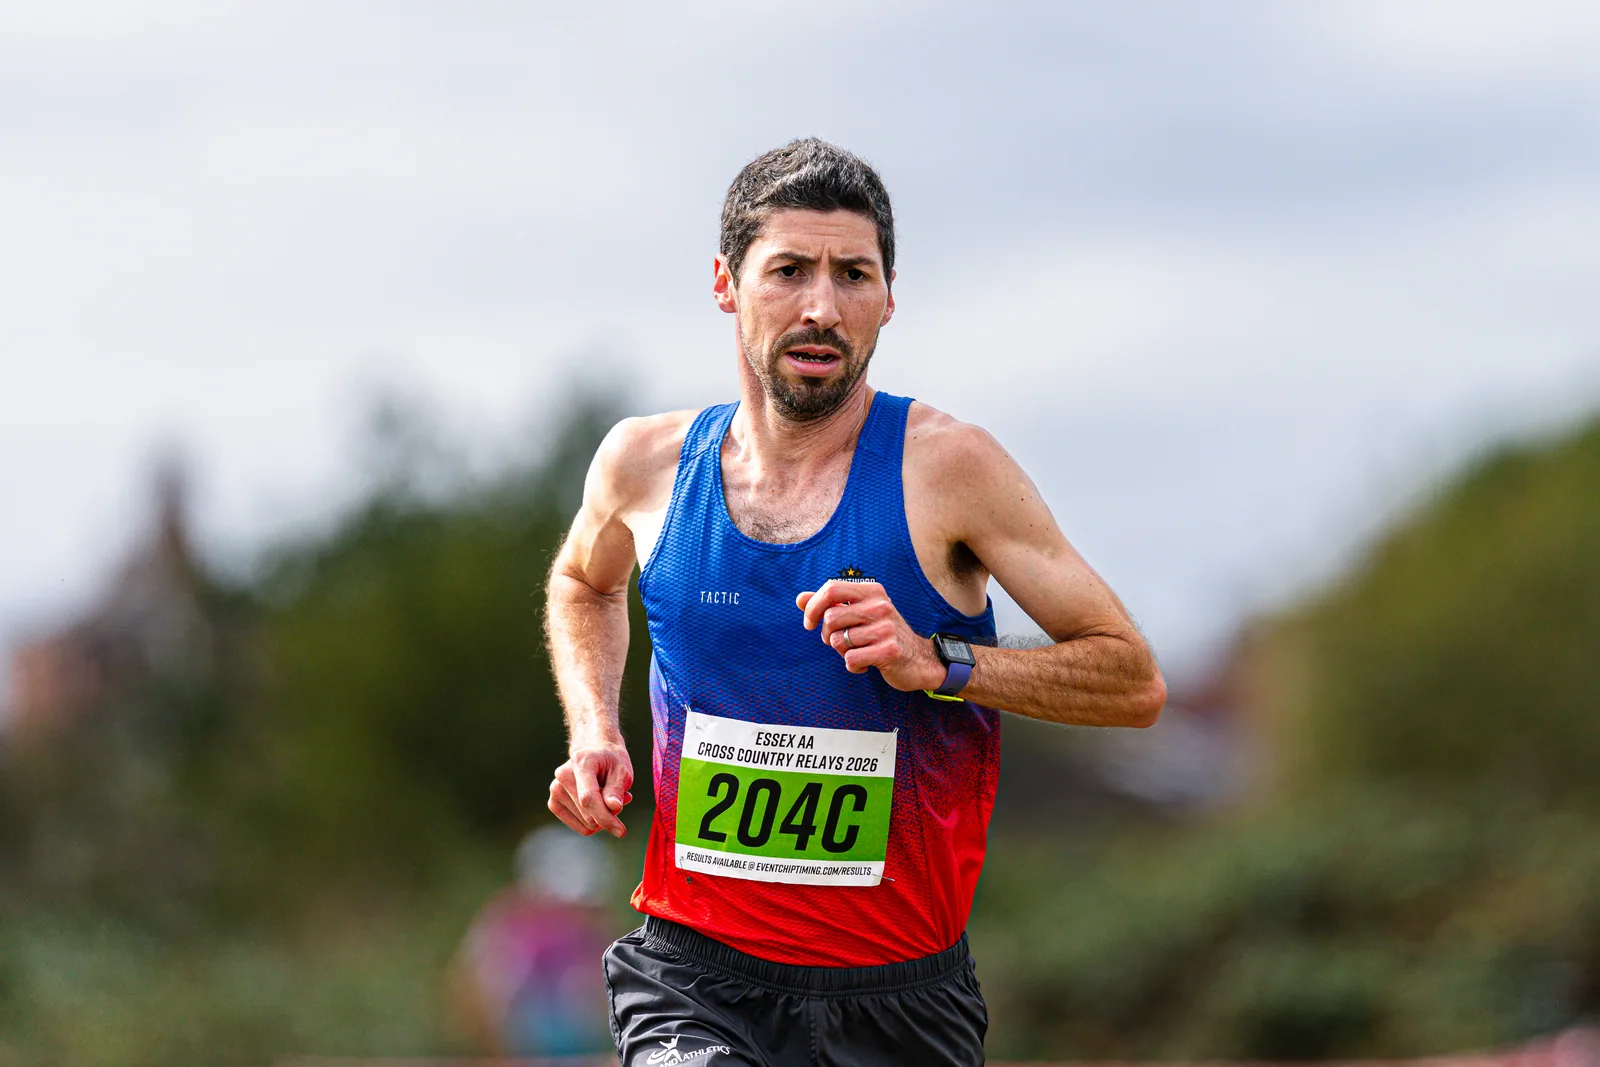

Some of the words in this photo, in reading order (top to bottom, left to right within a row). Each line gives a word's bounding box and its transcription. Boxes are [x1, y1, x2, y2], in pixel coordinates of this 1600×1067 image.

[700, 591, 740, 604] TACTIC
[755, 731, 796, 748] ESSEX
[797, 735, 815, 749] AA
[697, 741, 734, 760] CROSS
[737, 749, 794, 767] COUNTRY
[795, 754, 844, 770] RELAYS
[845, 757, 878, 772] 2026
[697, 773, 868, 854] 204C
[686, 851, 712, 864] RESULTS
[712, 857, 747, 869] AVAILABLE
[747, 862, 756, 871] @
[756, 862, 872, 876] EVENTCHIPTIMING.COM/RESULTS
[682, 1045, 730, 1061] ATHLETICS
